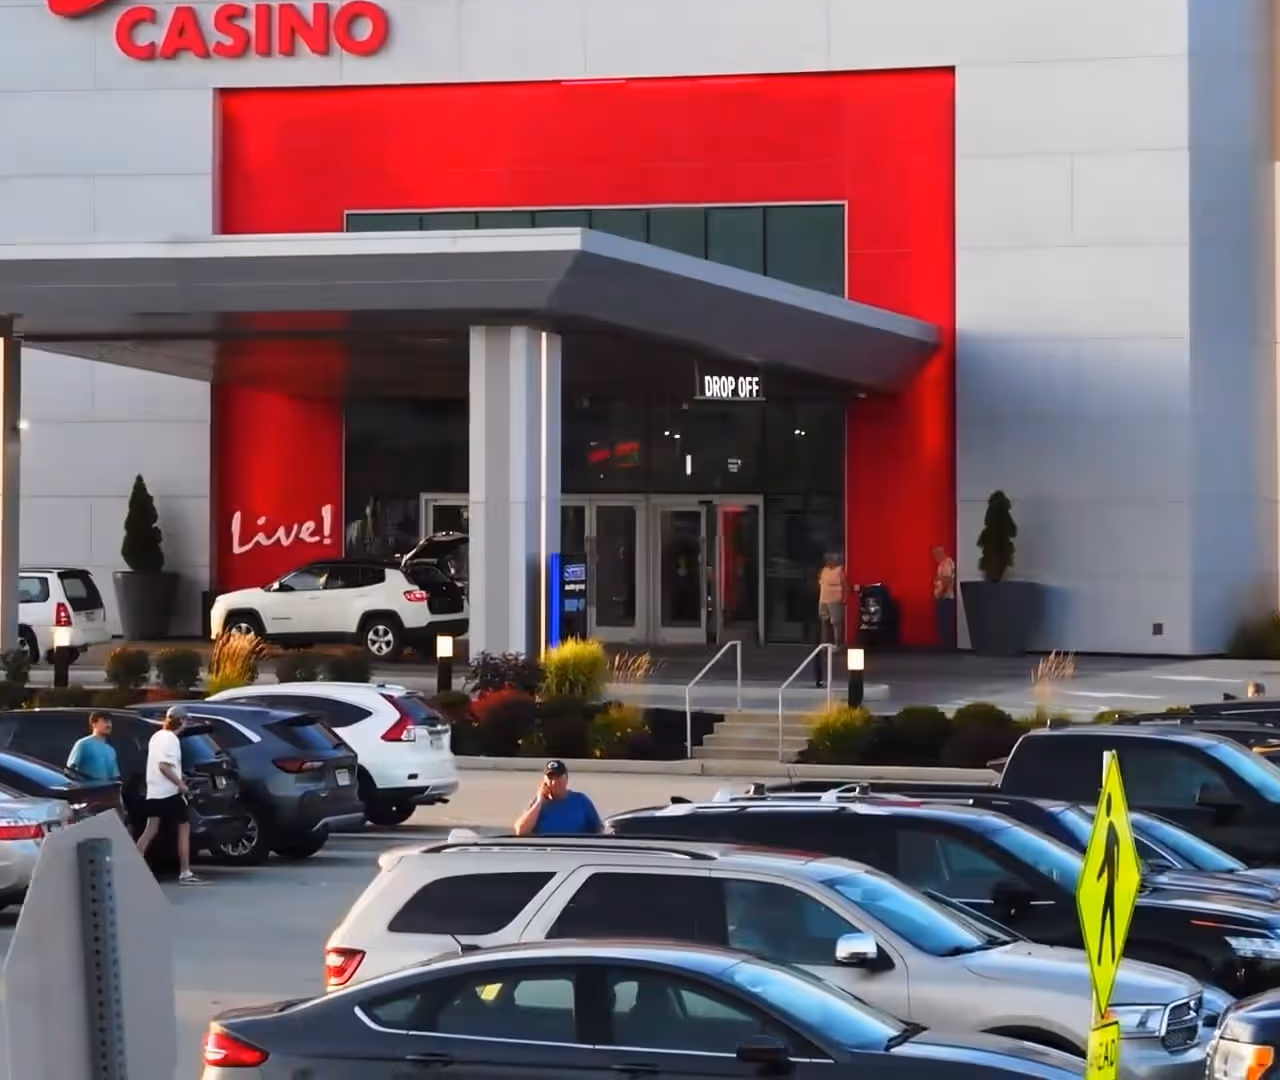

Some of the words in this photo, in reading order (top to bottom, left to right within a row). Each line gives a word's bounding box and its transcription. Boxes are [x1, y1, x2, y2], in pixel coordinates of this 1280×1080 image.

[113, 0, 389, 61] CASINO
[704, 375, 736, 398] DROP
[738, 376, 760, 398] OFF
[231, 503, 332, 555] Live!
